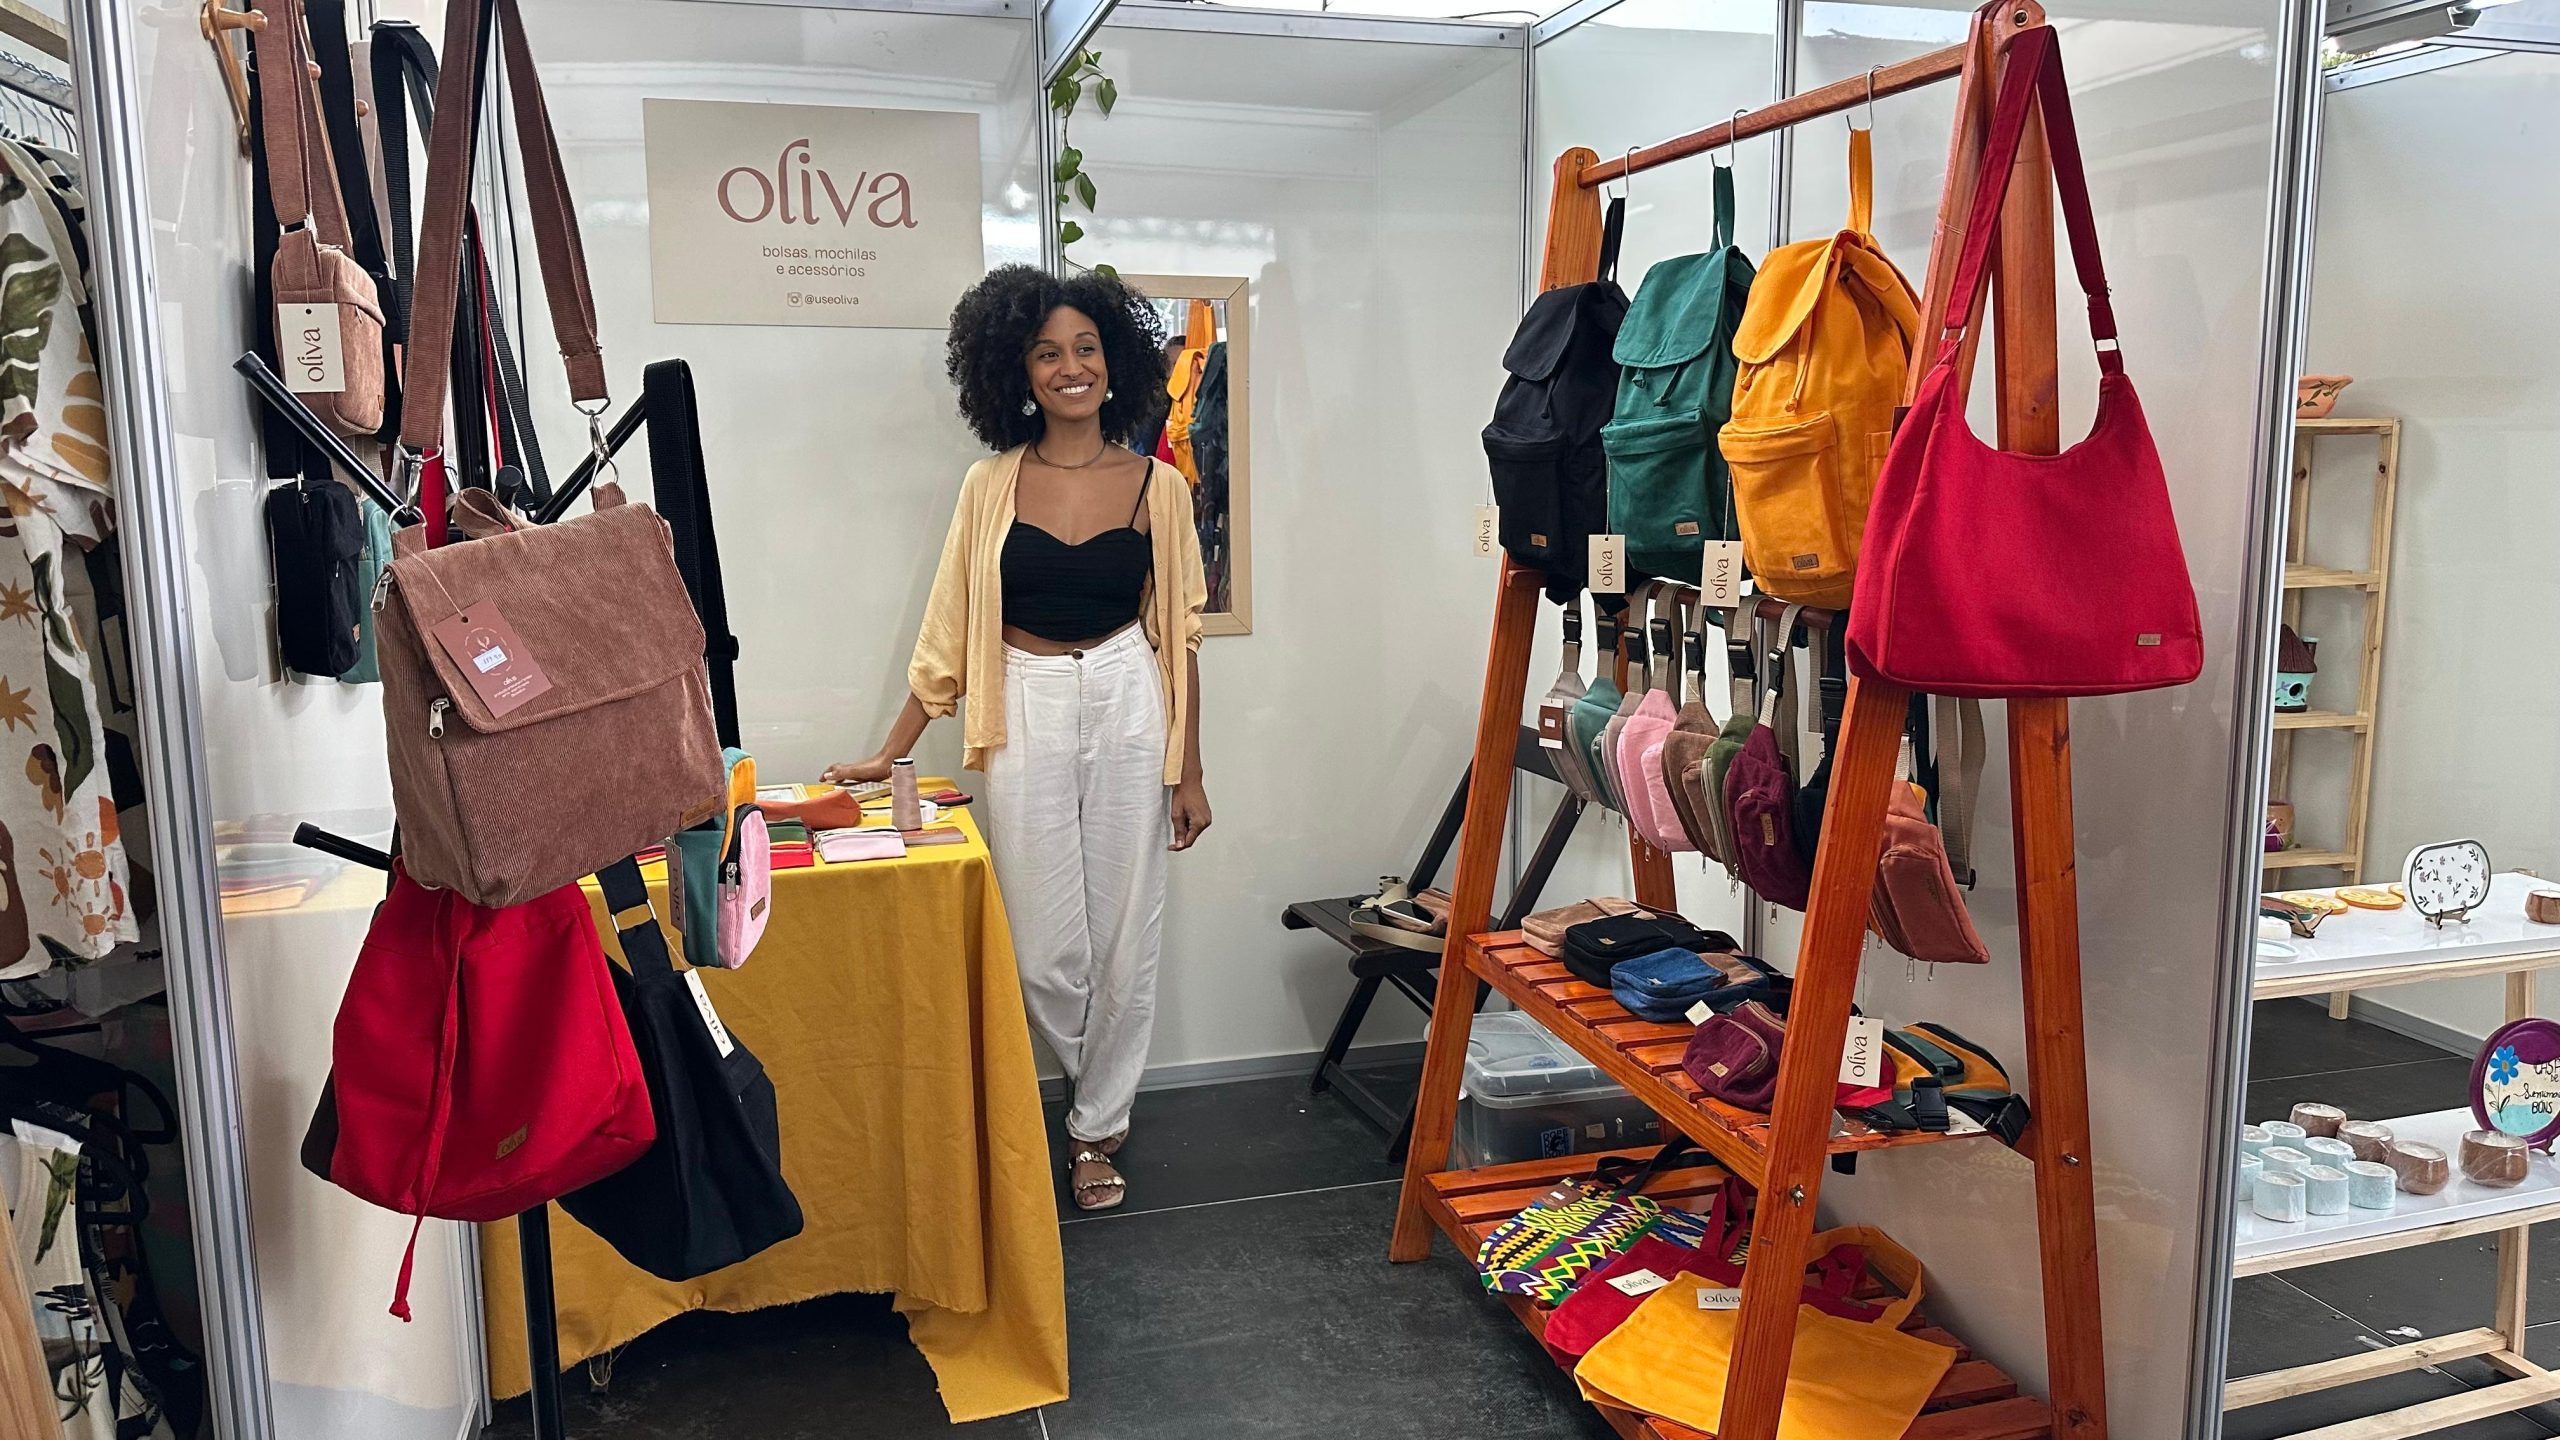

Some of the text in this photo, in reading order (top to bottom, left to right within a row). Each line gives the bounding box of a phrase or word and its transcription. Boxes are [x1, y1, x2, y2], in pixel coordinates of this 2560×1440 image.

[717, 138, 919, 229] oliva
[776, 264, 866, 278] e acessórios
[814, 248, 877, 261] mochilas
[804, 293, 860, 306] @useoliva
[297, 327, 325, 383] oliva
[1478, 519, 1491, 552] oliva
[1597, 549, 1614, 587] oliva
[1710, 557, 1730, 599] oliva
[1846, 1035, 1868, 1078] oliva
[1622, 1278, 1651, 1290] oliva
[1704, 1293, 1741, 1303] oliva
